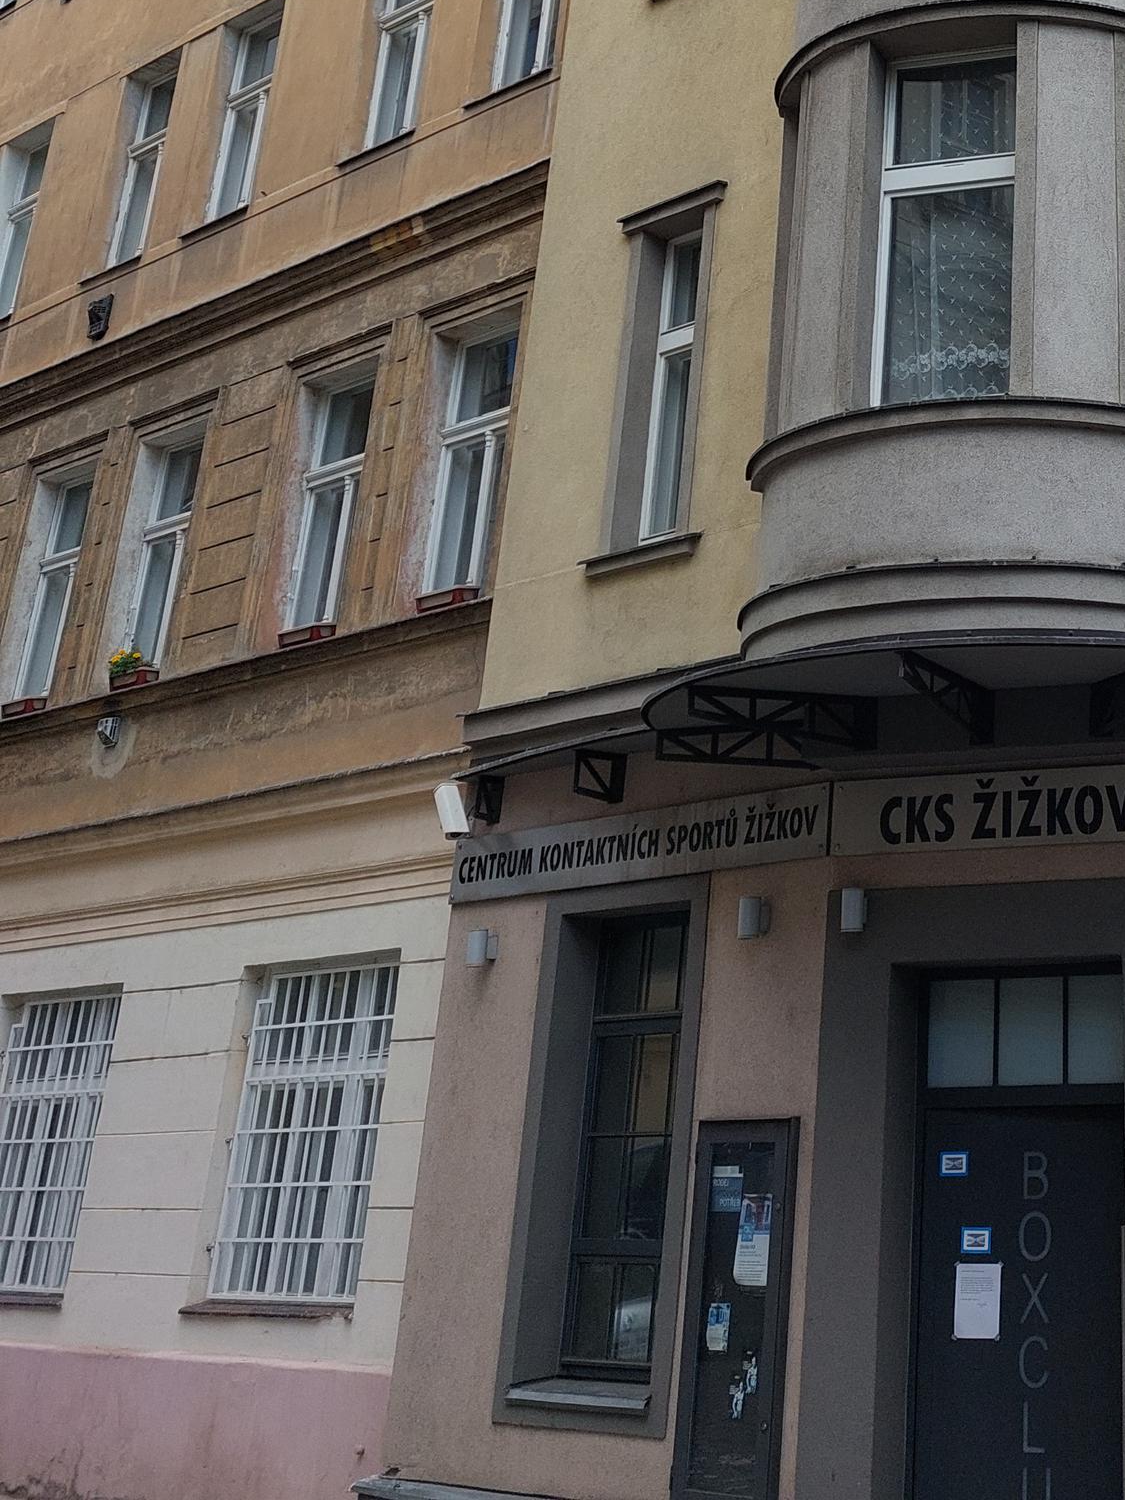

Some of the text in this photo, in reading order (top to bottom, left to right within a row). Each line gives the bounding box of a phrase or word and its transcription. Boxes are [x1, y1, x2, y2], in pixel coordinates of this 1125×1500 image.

[459, 803, 819, 884] CENTRUM KONTAKTNÍCH SPORTŮ ŽIŽKOV
[880, 793, 955, 845] CKS
